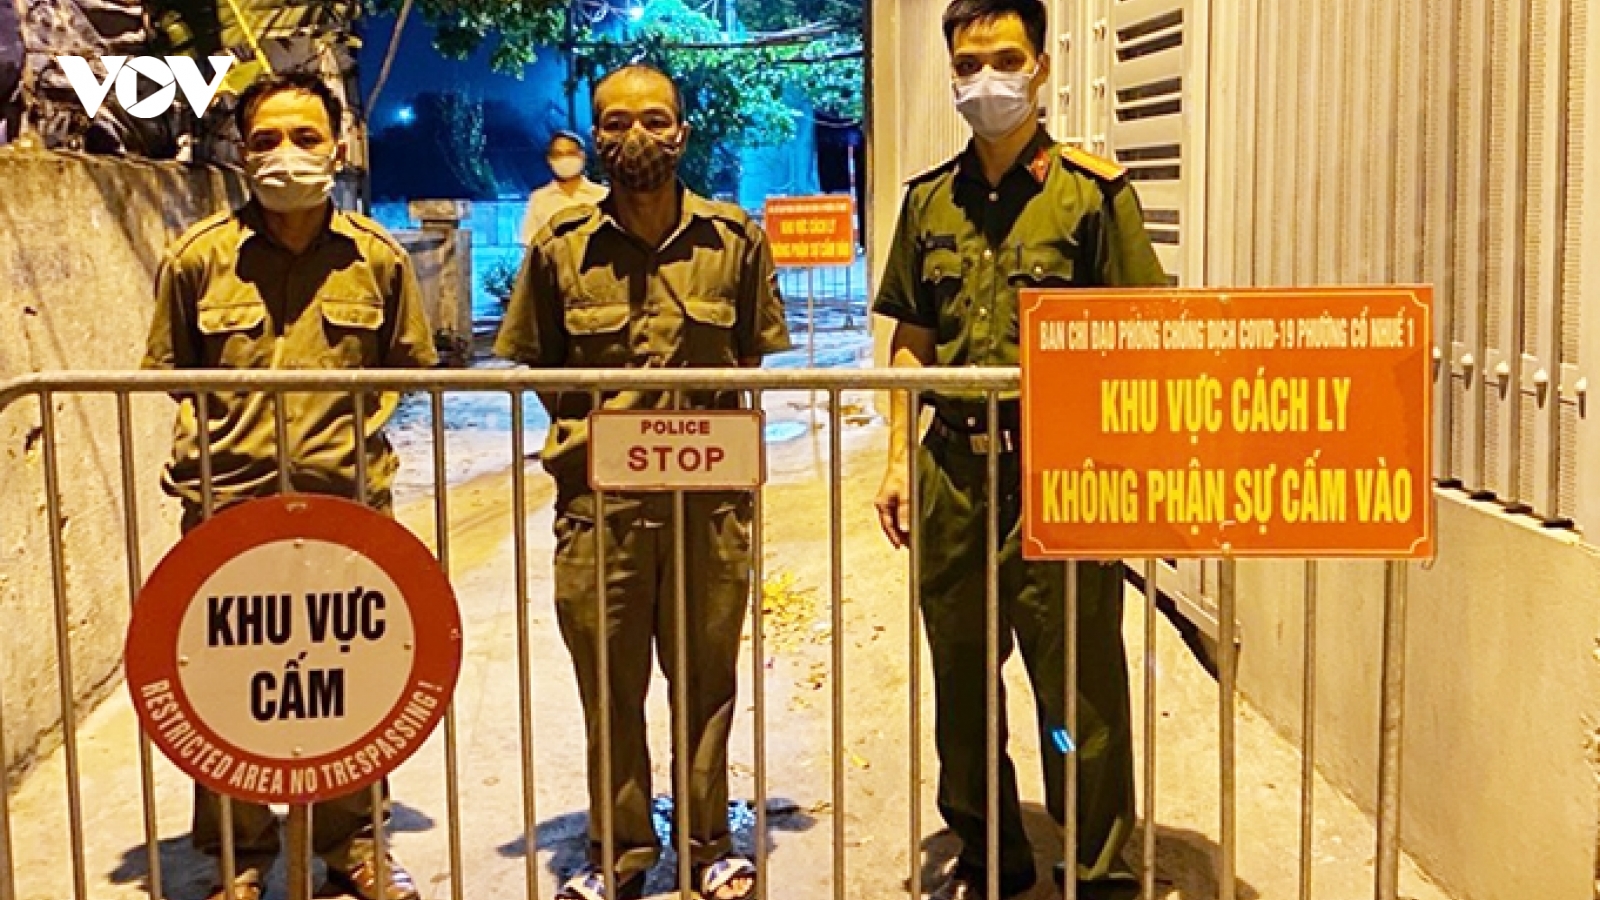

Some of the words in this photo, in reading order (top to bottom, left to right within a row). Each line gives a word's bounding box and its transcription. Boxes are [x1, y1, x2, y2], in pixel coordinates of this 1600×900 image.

[1407, 318, 1415, 348] 1
[640, 419, 711, 435] POLICE
[1101, 379, 1158, 433] KHU
[1167, 373, 1222, 444] VỰC
[1231, 367, 1308, 432] CÁCH
[1317, 377, 1351, 432] LY
[627, 445, 725, 472] STOP
[1042, 457, 1138, 524] KHÔNG
[1147, 457, 1225, 535] PHẬN
[1234, 464, 1277, 535] SỰ
[1282, 449, 1347, 523] CẤM
[1355, 457, 1413, 523] VÀO
[207, 595, 292, 647] KHU
[305, 586, 387, 652] VỰC
[250, 651, 345, 721] CẤM
[140, 678, 233, 779] RESTRICTED
[228, 761, 284, 794] AREA
[289, 769, 319, 794] NO
[321, 690, 438, 788] TRESPASSING
